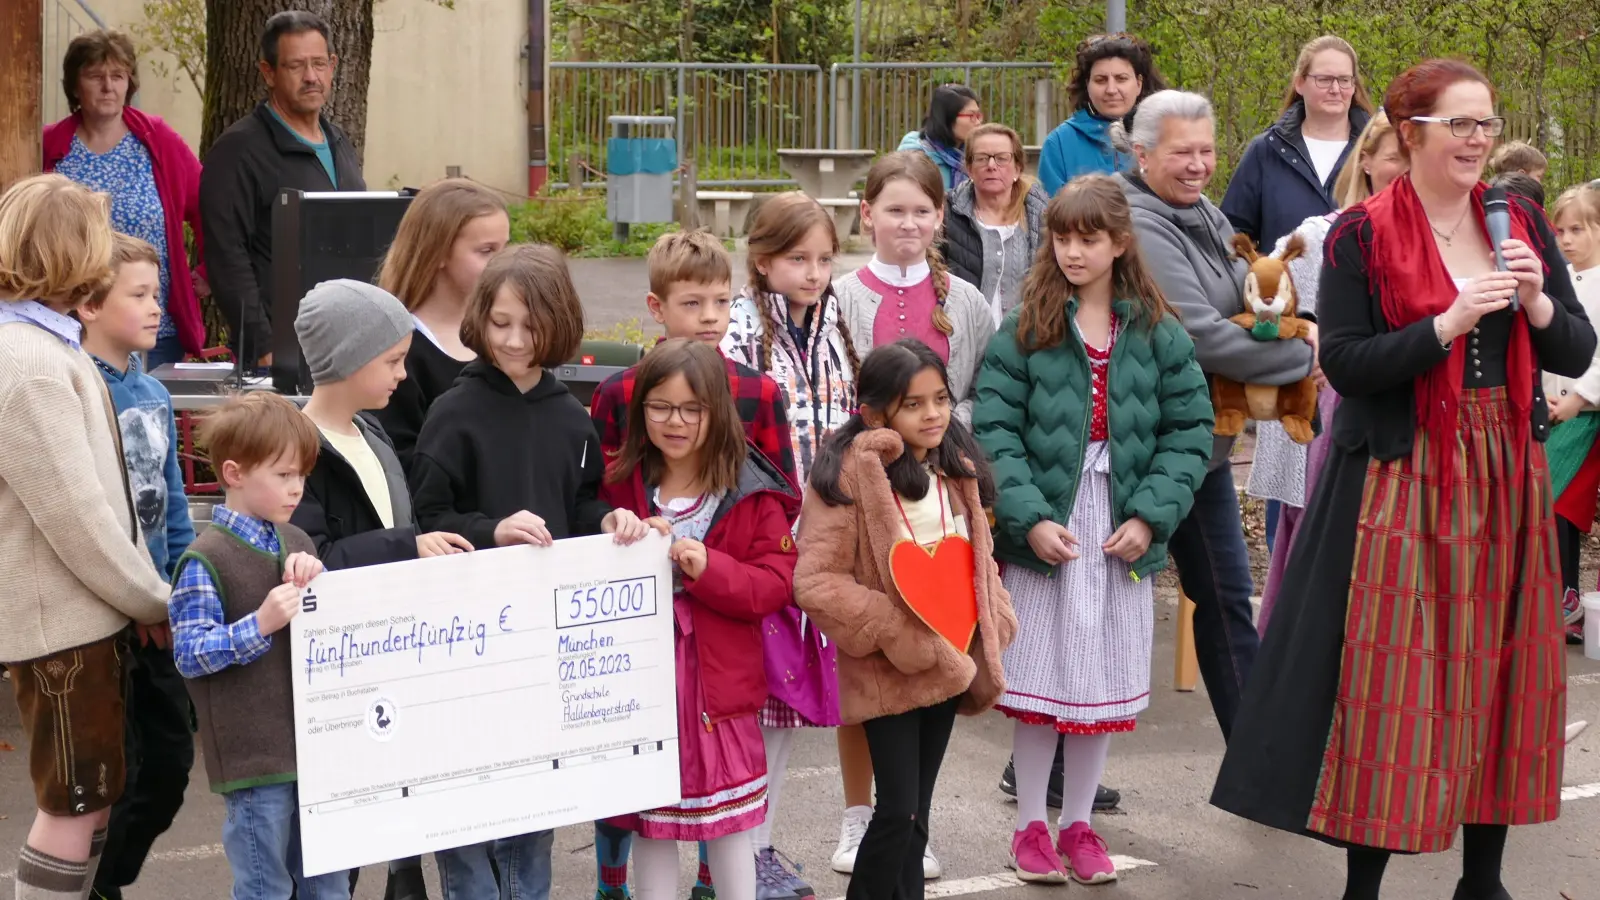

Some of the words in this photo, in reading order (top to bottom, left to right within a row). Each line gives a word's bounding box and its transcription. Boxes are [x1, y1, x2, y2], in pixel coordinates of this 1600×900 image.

[570, 583, 643, 619] 550,00
[303, 624, 327, 638] Zahlen
[328, 623, 340, 635] Sie
[342, 621, 364, 634] gegen
[365, 617, 389, 630] diesen
[389, 614, 416, 626] Scheck
[306, 616, 485, 685] fünfhundertfünfzig
[498, 605, 512, 632] €
[558, 629, 614, 654] München
[558, 653, 631, 681] 02.05.2023
[321, 691, 340, 701] Betrag
[347, 685, 379, 697] Buchstaben
[562, 684, 610, 704] Grundschule
[307, 716, 316, 724] an
[307, 725, 323, 735] oder
[325, 718, 364, 732] Überbringer
